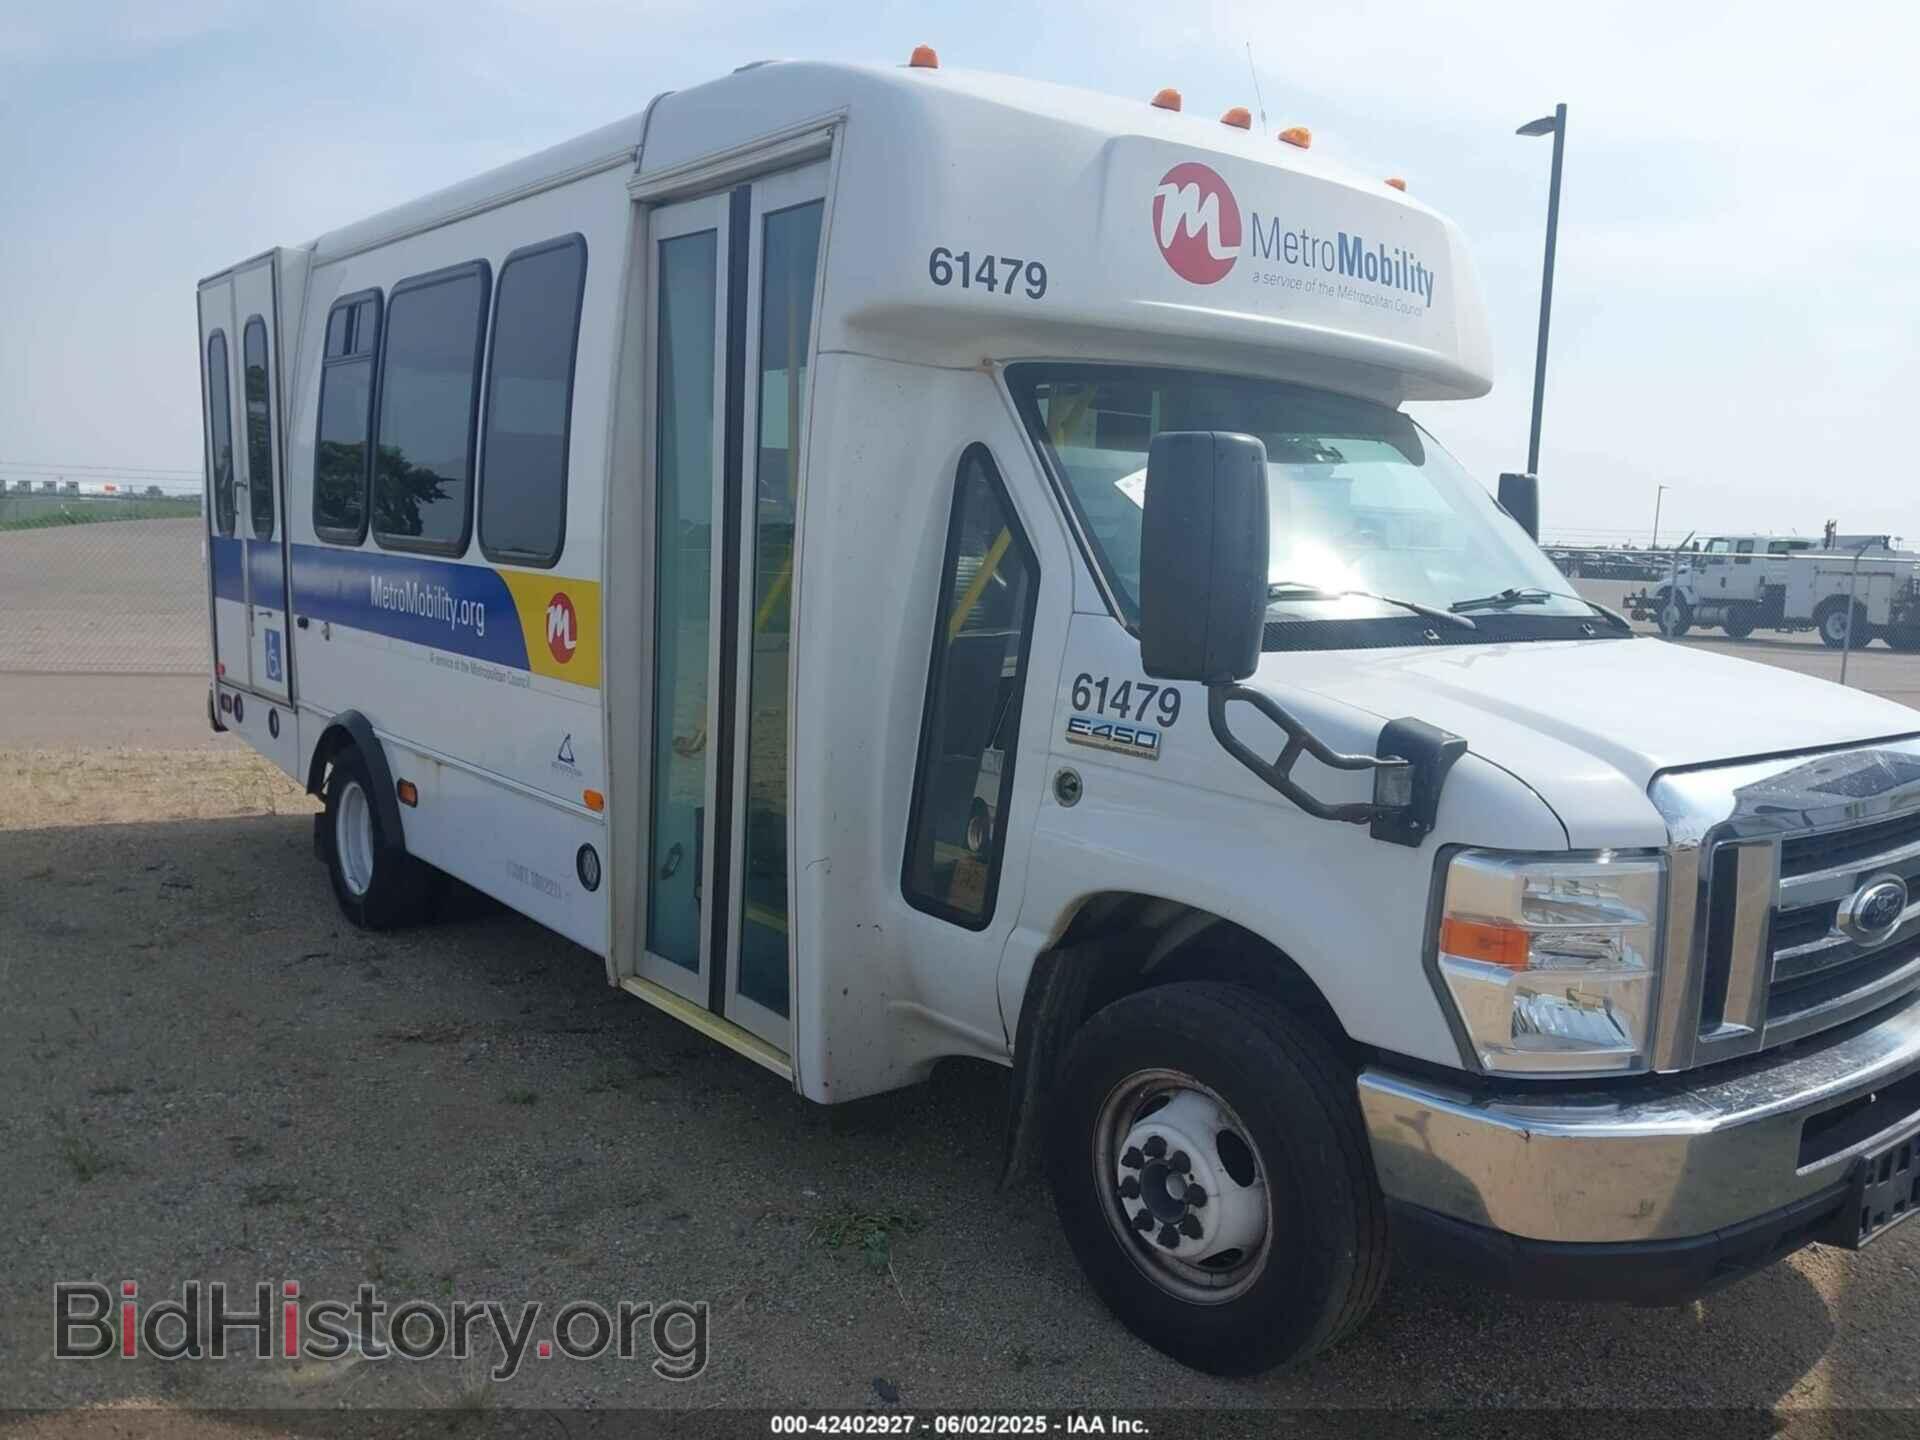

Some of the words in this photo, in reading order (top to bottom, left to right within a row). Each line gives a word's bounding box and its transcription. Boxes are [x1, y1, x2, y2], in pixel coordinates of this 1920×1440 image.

[929, 247, 1048, 299] 61479
[1252, 212, 1434, 308] MetroMobility
[1252, 272, 1260, 282] a
[1263, 274, 1302, 290] service
[1305, 279, 1316, 292] of
[1318, 282, 1334, 296] the
[1337, 286, 1394, 309] Metropolitan
[370, 576, 485, 637] MetroMobility.org
[1072, 673, 1181, 727] 61479
